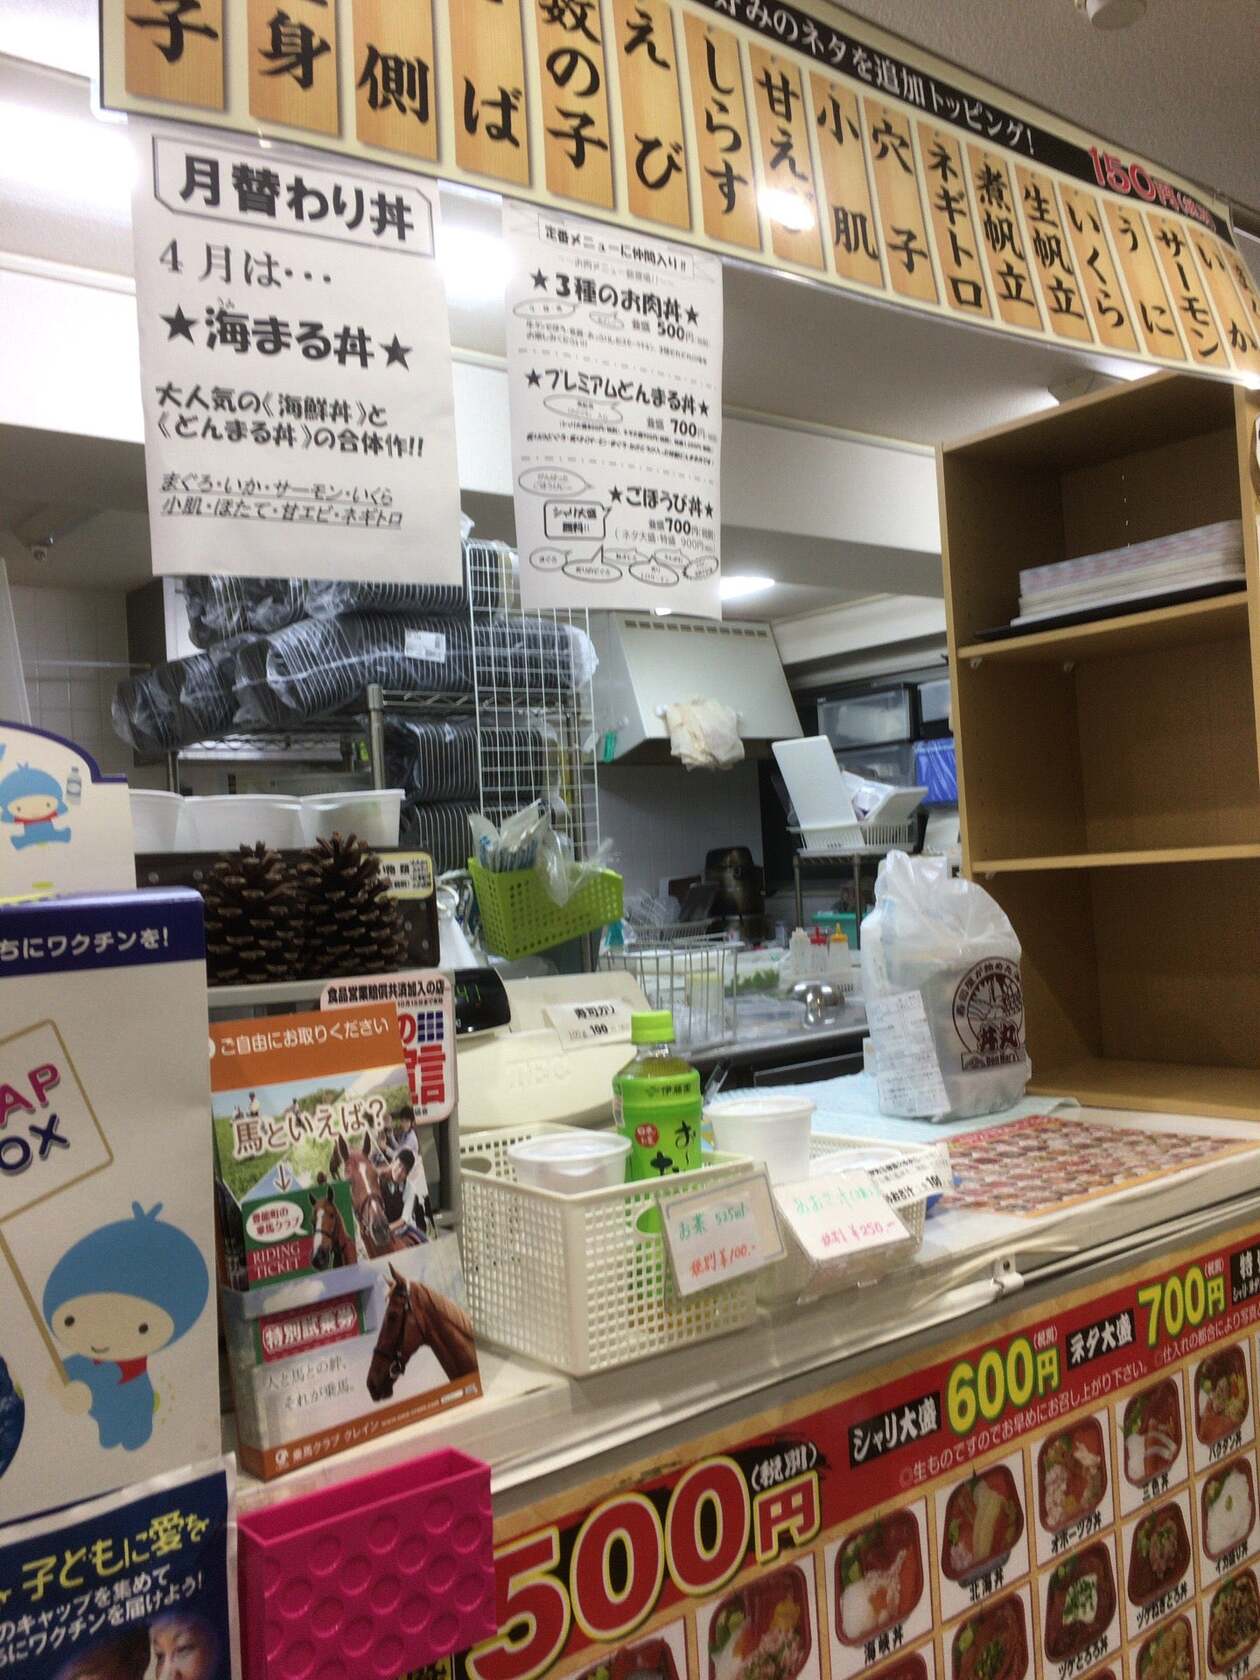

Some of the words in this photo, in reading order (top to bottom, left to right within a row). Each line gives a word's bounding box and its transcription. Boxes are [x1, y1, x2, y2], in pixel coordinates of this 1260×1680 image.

[357, 43, 430, 124] 側
[624, 7, 684, 191] えび
[703, 33, 750, 215] しらす
[756, 67, 813, 205] 甘え
[817, 93, 880, 262] 小肌
[179, 153, 415, 240] 月替わり丼
[872, 118, 928, 274] 穴子
[928, 141, 983, 309] ネギトロ
[976, 160, 1035, 307] 煮帆立
[1024, 183, 1084, 320] 生帆立
[1067, 202, 1124, 328] いくら
[1119, 215, 1175, 335] うに
[1157, 229, 1219, 357] サーモン
[204, 304, 375, 368] 海まる丼
[555, 272, 683, 323] 3種のお肉丼
[1197, 244, 1259, 353] いか
[155, 381, 389, 428] 大人気の《海鮮丼》と
[158, 410, 424, 458] 《どんまる丼》の合体作!!
[545, 368, 696, 416] プレミアムどんまる丼
[161, 471, 393, 507] まぐろ・いか・サーモン・いくら
[162, 495, 404, 528] 小肌・ほたて・甘エビ・ネギトロ
[626, 485, 702, 518] ごほうび丼
[221, 1017, 390, 1057] ご自由にお取りください
[234, 1098, 386, 1157] 馬といえば?
[252, 1241, 301, 1265] RIDING
[256, 1256, 299, 1279] TICKET
[1070, 1312, 1133, 1365] ネタ大盛
[1137, 1264, 1226, 1349] 700円
[853, 1395, 938, 1462] シャリ大盛
[947, 1336, 1061, 1435] 600円
[22, 1510, 210, 1601] 子どもに愛を
[465, 1454, 823, 1680] 500円
